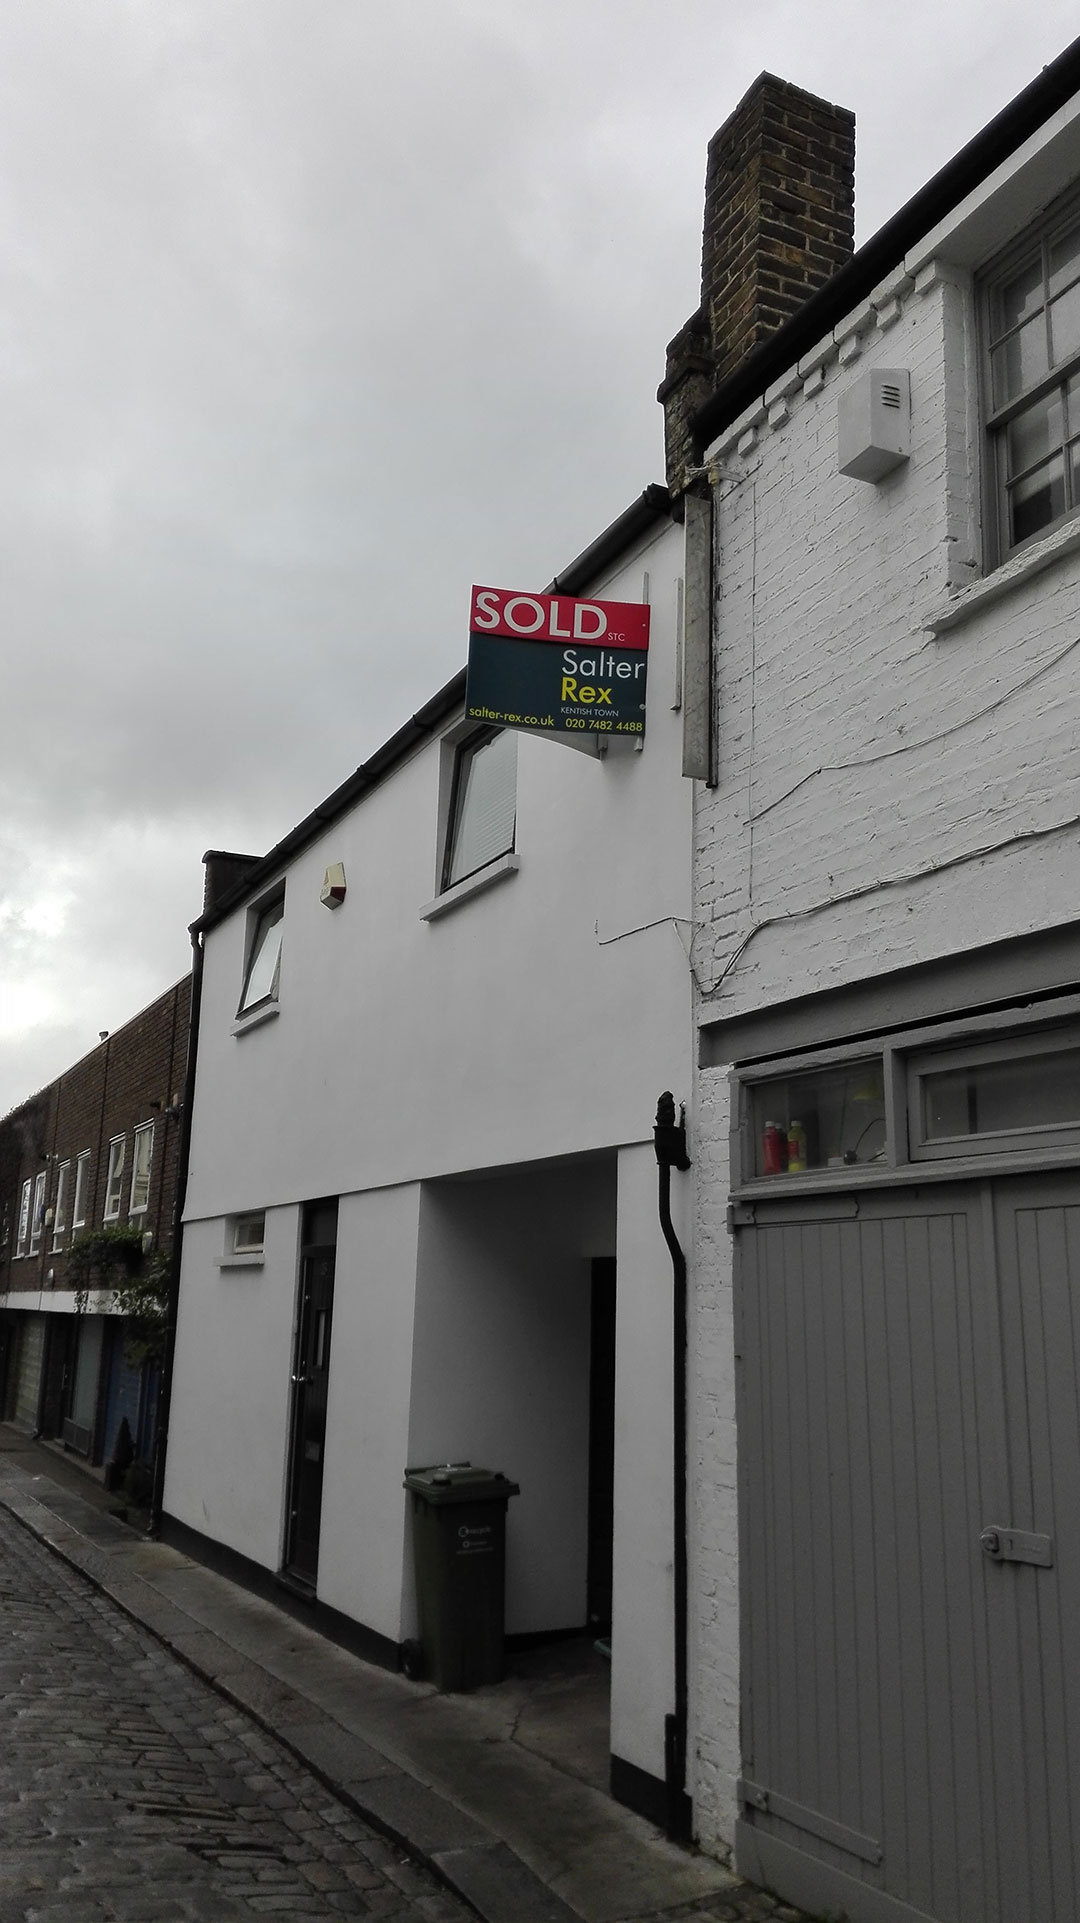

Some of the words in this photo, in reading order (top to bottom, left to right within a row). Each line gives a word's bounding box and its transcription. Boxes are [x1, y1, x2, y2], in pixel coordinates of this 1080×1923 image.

[474, 592, 607, 639] SOLD
[607, 632, 625, 642] STC
[561, 649, 645, 679] Salter
[561, 677, 612, 704] Rex
[469, 706, 554, 726] salter-rex.co.uk
[560, 706, 592, 715] KENTISH
[594, 709, 619, 717] TOWN
[565, 718, 585, 729] 020
[589, 719, 612, 730] 7482
[616, 722, 642, 731] 4488
